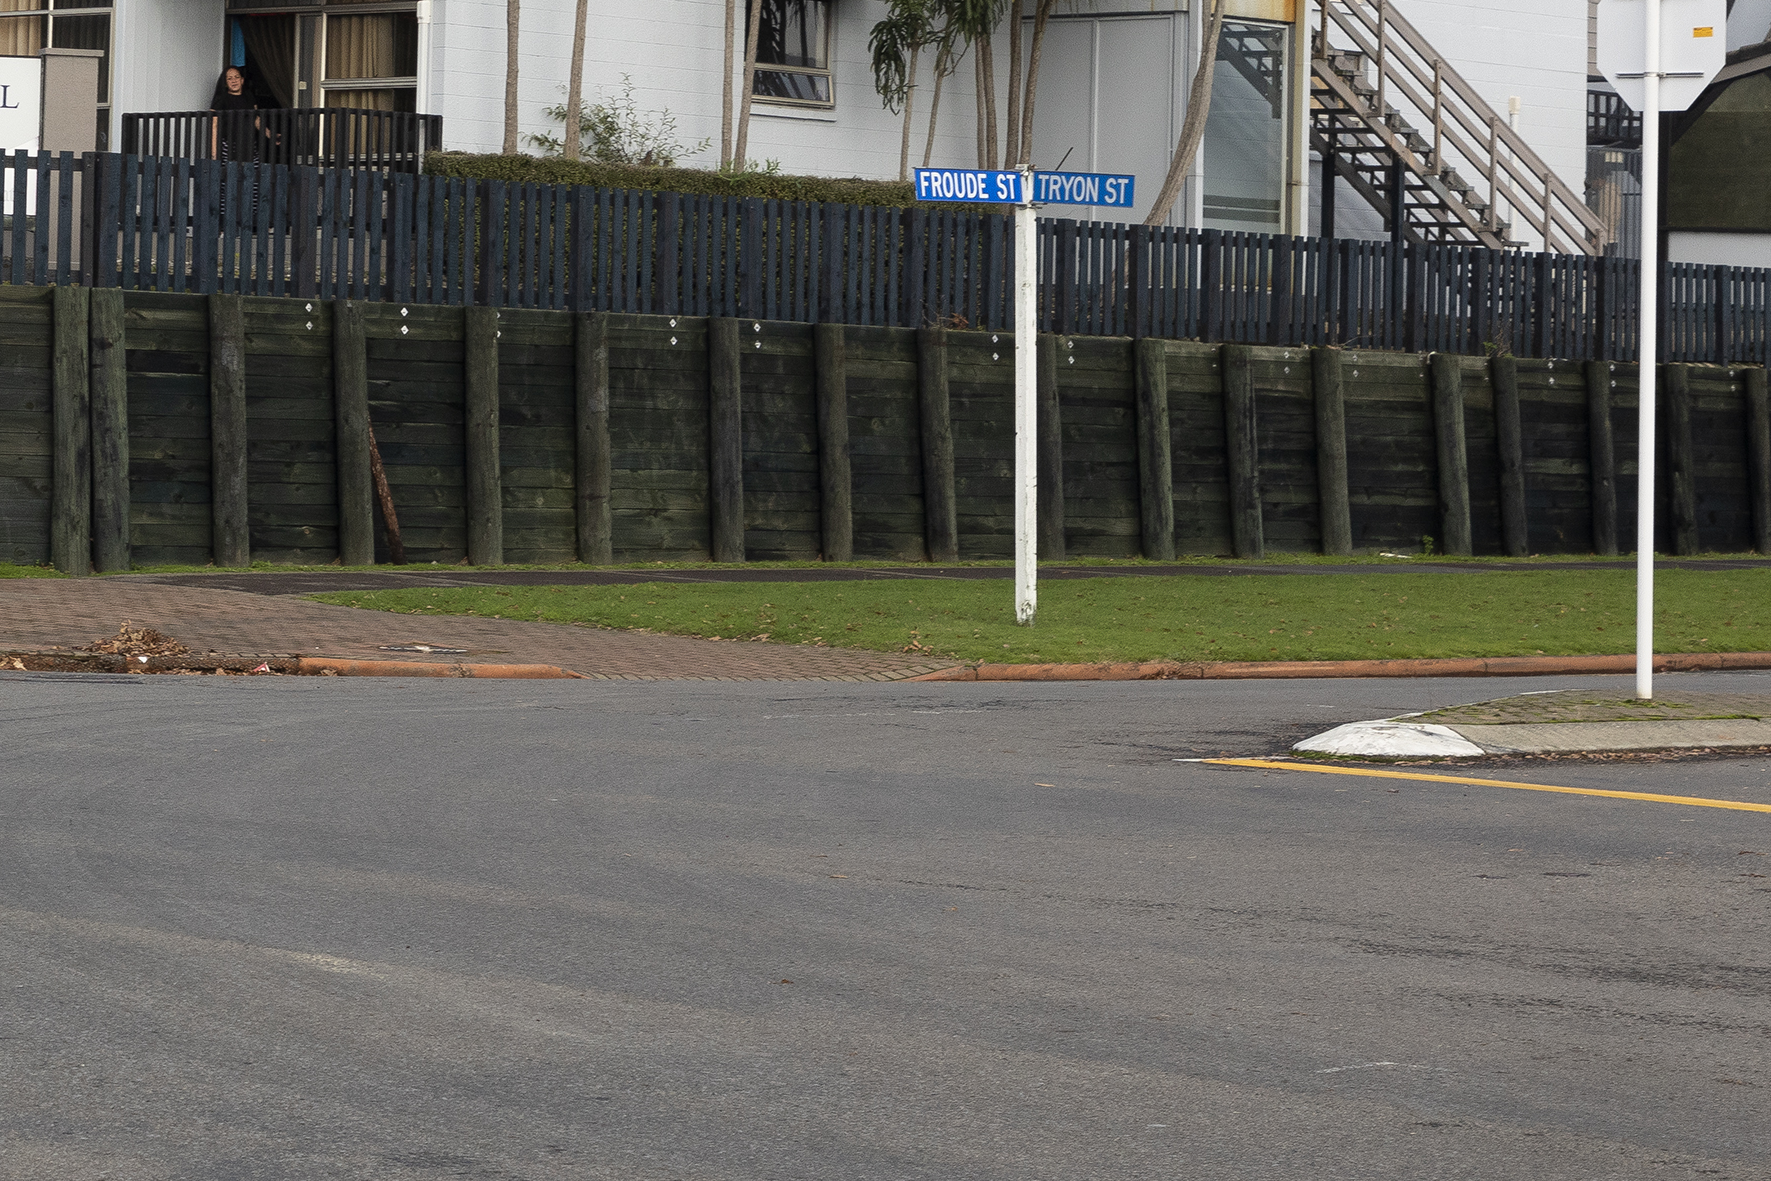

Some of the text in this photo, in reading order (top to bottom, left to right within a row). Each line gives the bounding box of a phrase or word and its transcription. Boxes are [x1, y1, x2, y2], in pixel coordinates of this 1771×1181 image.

[919, 171, 1016, 200] FROUDE ST
[1038, 174, 1129, 204] TRYON ST
